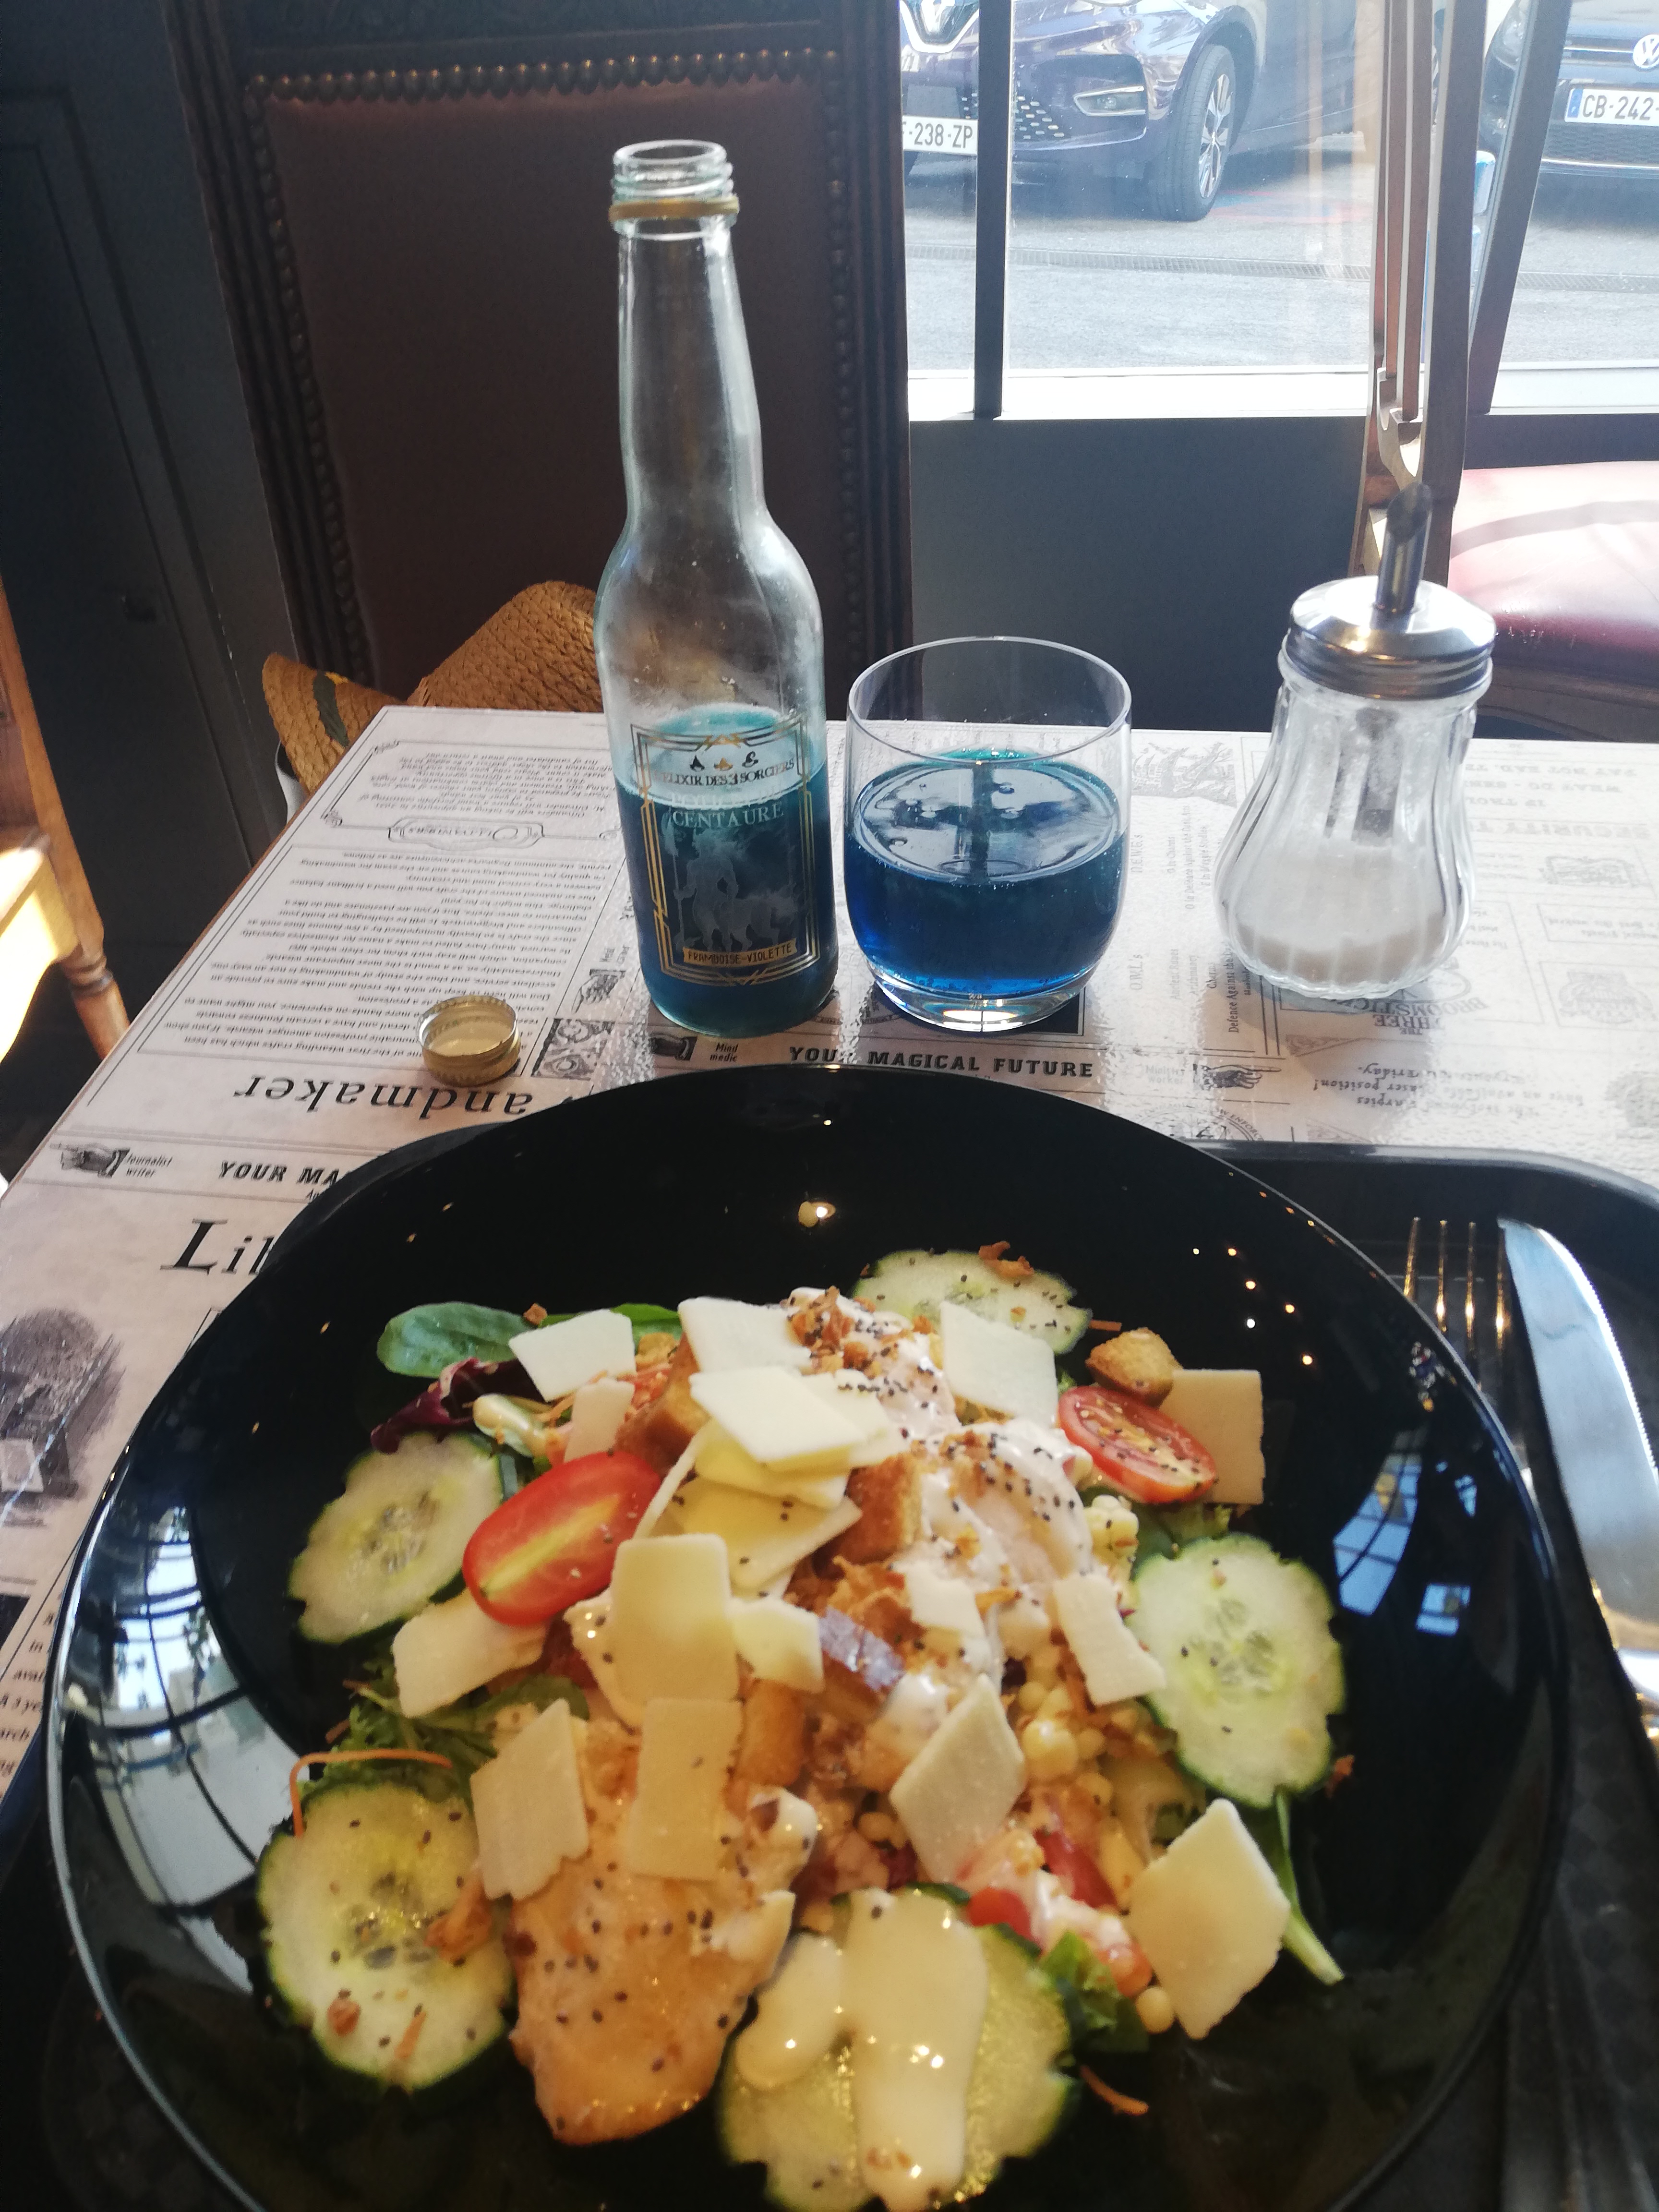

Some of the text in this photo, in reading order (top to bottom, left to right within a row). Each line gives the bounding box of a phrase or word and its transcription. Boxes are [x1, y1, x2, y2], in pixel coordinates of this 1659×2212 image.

[706, 775, 728, 786] DES
[740, 758, 794, 784] SORCIERS
[673, 802, 784, 829] CENTAURE
[1165, 836, 1176, 858] Charms
[1182, 833, 1192, 842] the
[1198, 826, 1208, 847] Studies
[1182, 844, 1193, 867] Against
[1200, 849, 1211, 872] Muggle
[1183, 869, 1194, 893] Defence
[688, 942, 792, 964] FRAMBOISE VIOLETTE
[1224, 958, 1235, 969] the
[1129, 954, 1143, 990] O.W.L.'s
[1168, 948, 1180, 999] Ancient Runes
[1188, 954, 1200, 995] Arithmancy
[1205, 962, 1217, 989] Charms
[1224, 971, 1238, 999] Against
[1227, 1001, 1239, 1033] Defence
[1332, 996, 1489, 1017] BROOMSTIC
[1398, 1027, 1422, 1035] THE
[709, 1052, 738, 1062] medic
[716, 1043, 740, 1053] Mind
[790, 1046, 1094, 1078] YOU MAGICAL FUTURE
[1145, 1065, 1184, 1076] Ministry
[1312, 1078, 1379, 1091] position!
[1386, 1082, 1435, 1096] aser
[233, 1074, 535, 1121] andmaker
[1356, 1093, 1416, 1107] arpies
[218, 1160, 340, 1187] YOUR MA
